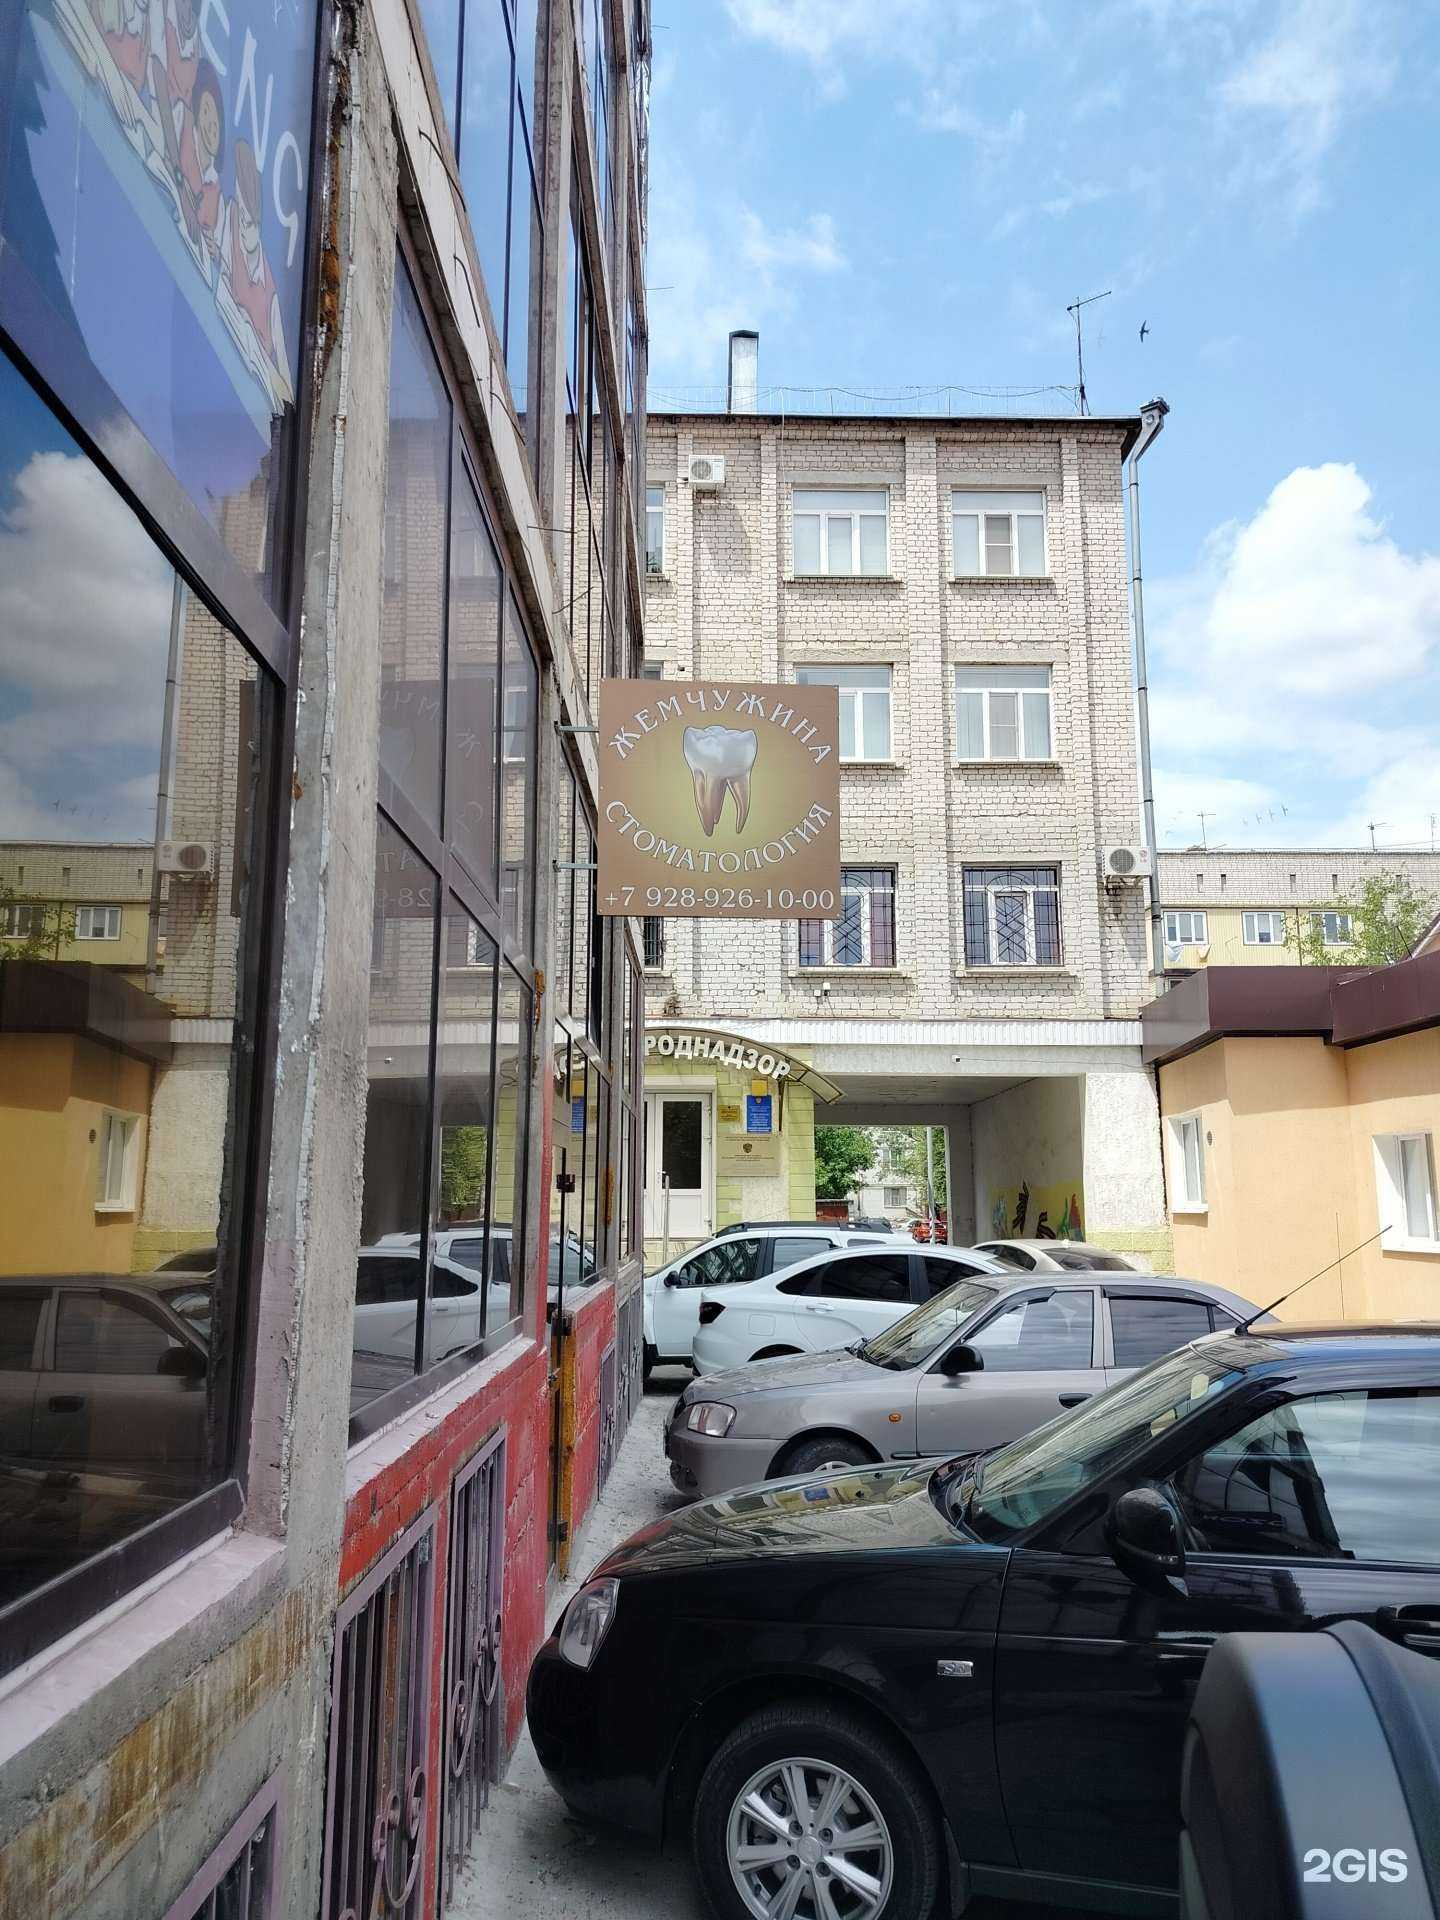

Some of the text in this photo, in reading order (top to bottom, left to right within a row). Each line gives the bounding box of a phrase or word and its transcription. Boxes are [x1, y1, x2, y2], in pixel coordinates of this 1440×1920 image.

[608, 688, 832, 764] ЖЕМЧУЖИНА
[605, 800, 832, 873] СТОМАТОЛОГИЯ
[604, 886, 834, 909] +7 928-926-10-00
